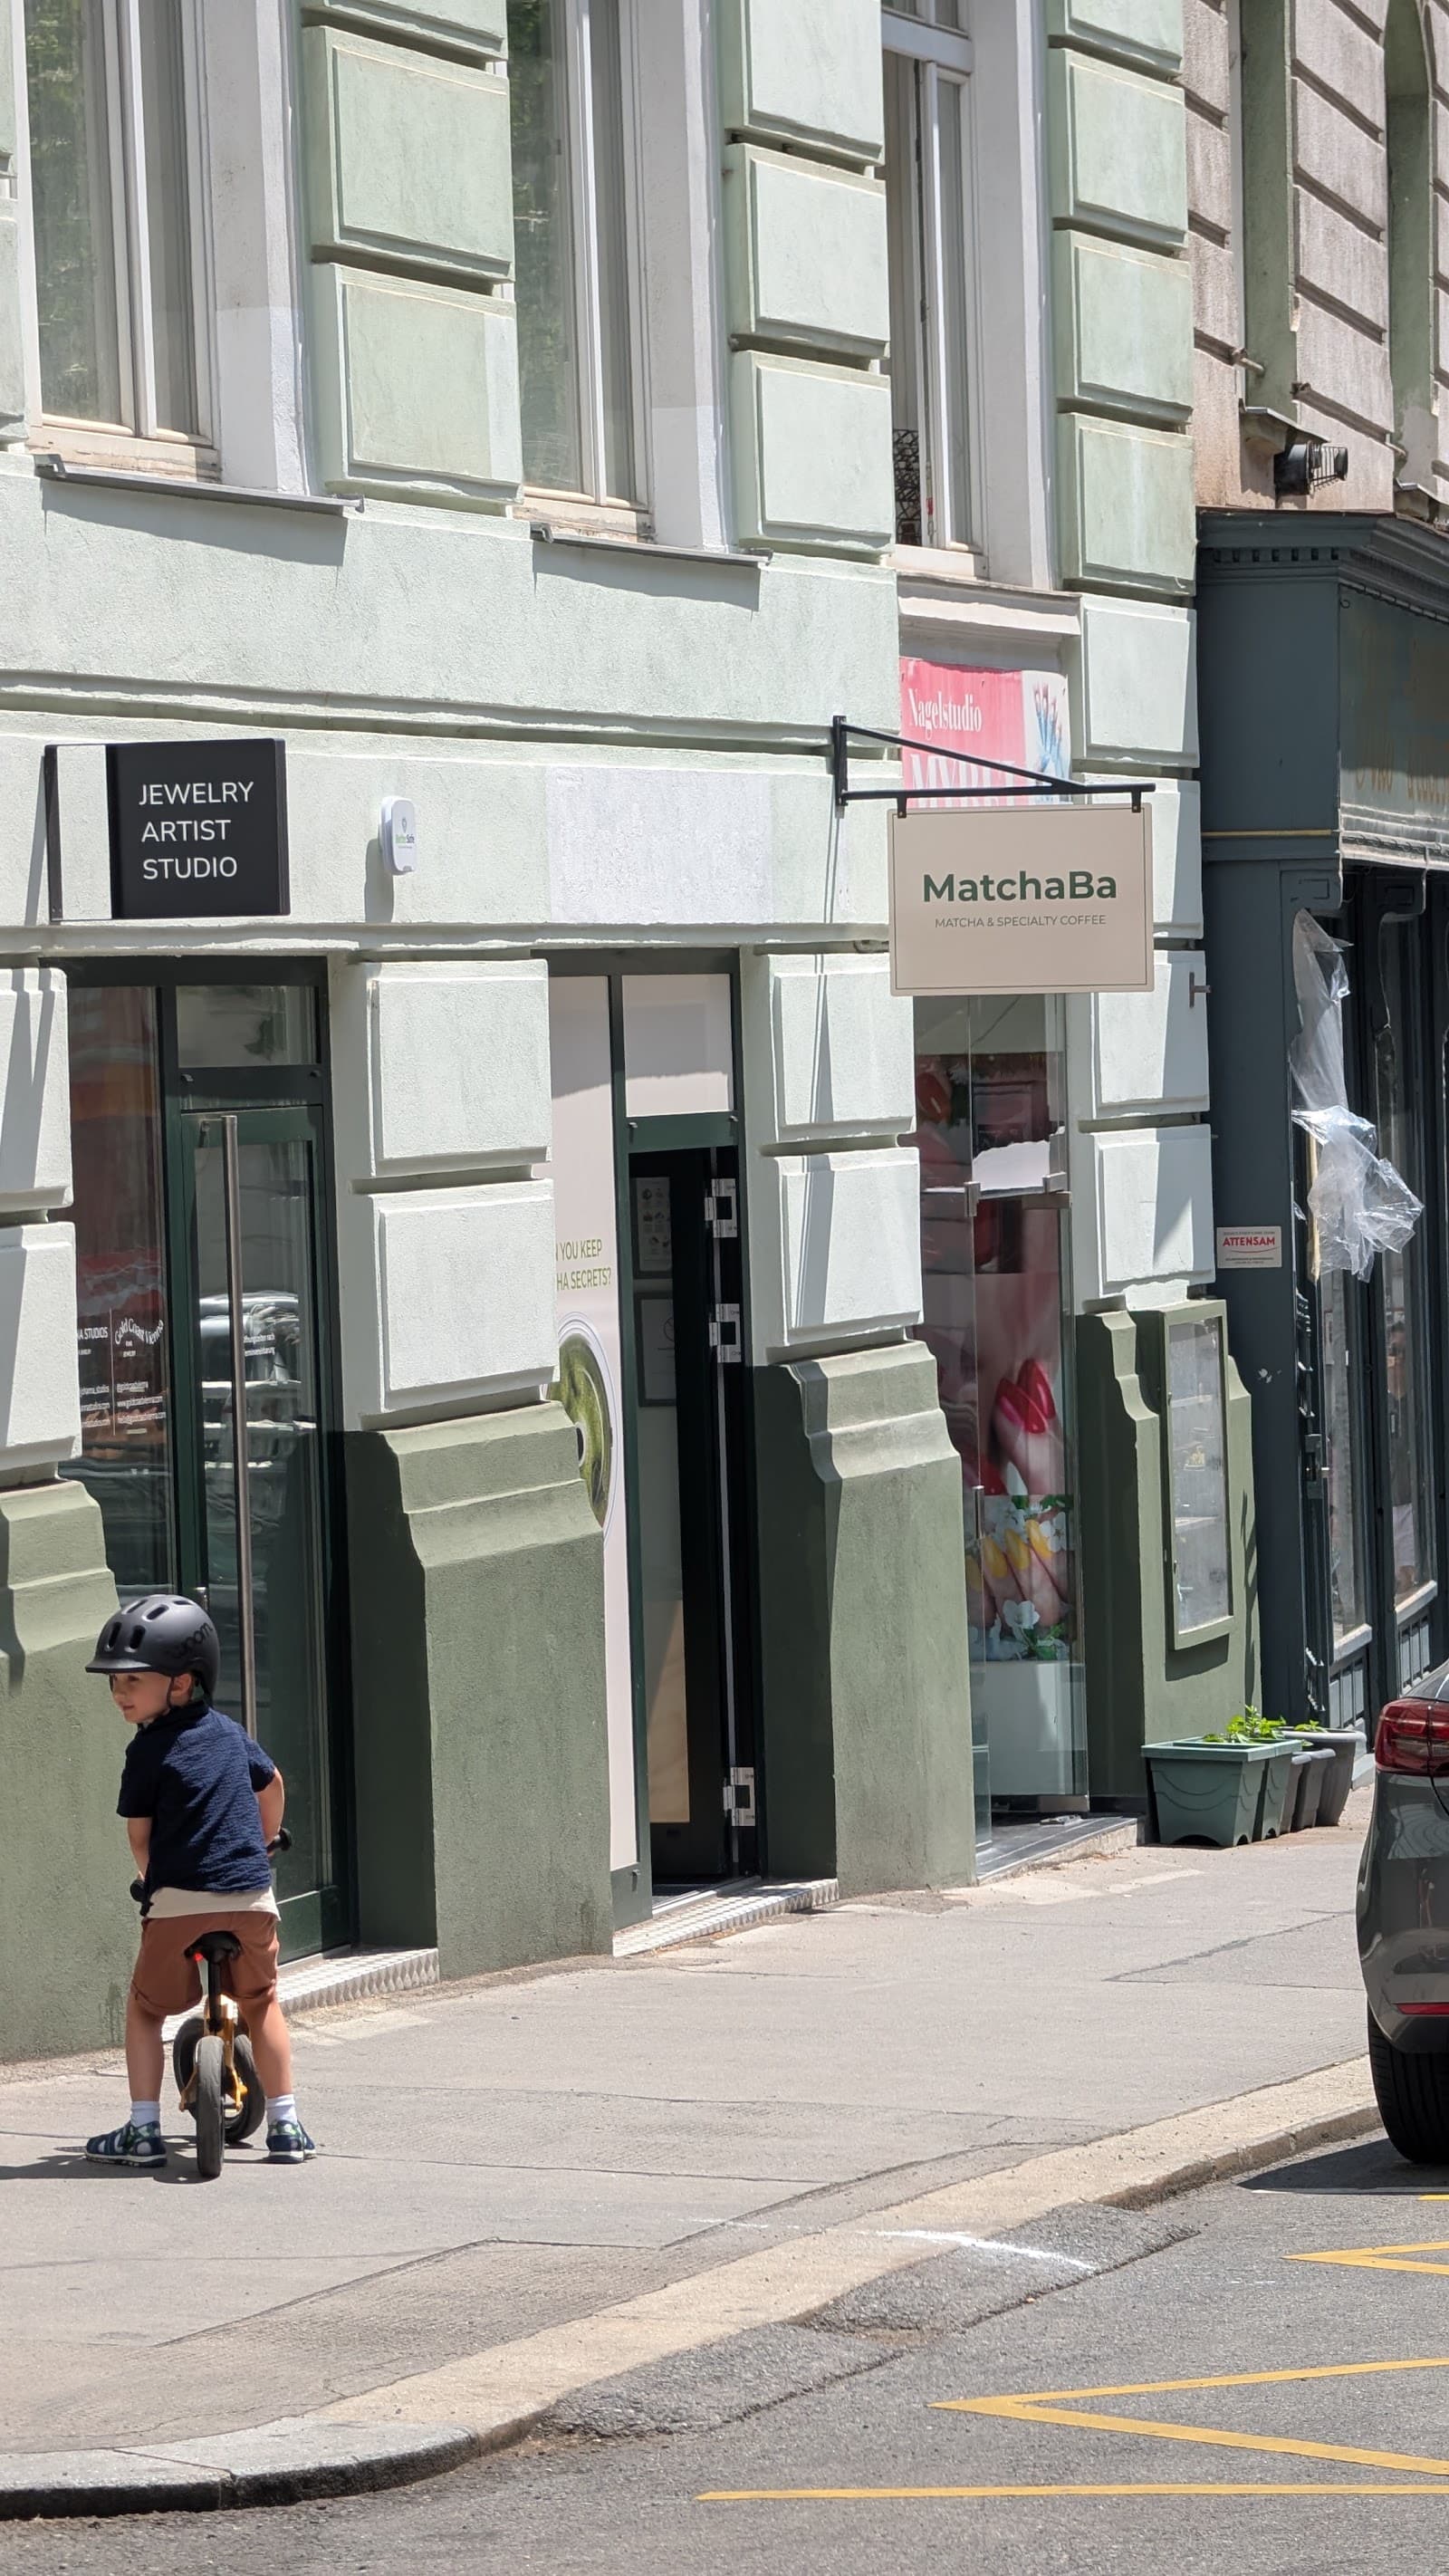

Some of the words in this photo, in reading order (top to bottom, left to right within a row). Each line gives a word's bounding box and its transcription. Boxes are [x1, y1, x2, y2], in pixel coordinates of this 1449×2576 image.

[908, 688, 983, 740] Nagelstudio
[139, 781, 254, 805] JEWELRY
[141, 819, 232, 842] ARTIST
[143, 856, 237, 879] STUDIO
[923, 870, 1117, 902] MatchaBa
[935, 917, 985, 928] MATCHA
[987, 917, 995, 928] &
[996, 915, 1058, 927] SPECIALTY
[1060, 914, 1107, 926] COFFEE
[560, 1242, 579, 1262] YOU
[580, 1238, 602, 1259] KEEP
[1223, 1236, 1276, 1247] ATTENSAM
[556, 1272, 570, 1292] HA
[571, 1266, 612, 1290] SECRETS?
[84, 1326, 109, 1340] STUDIOS
